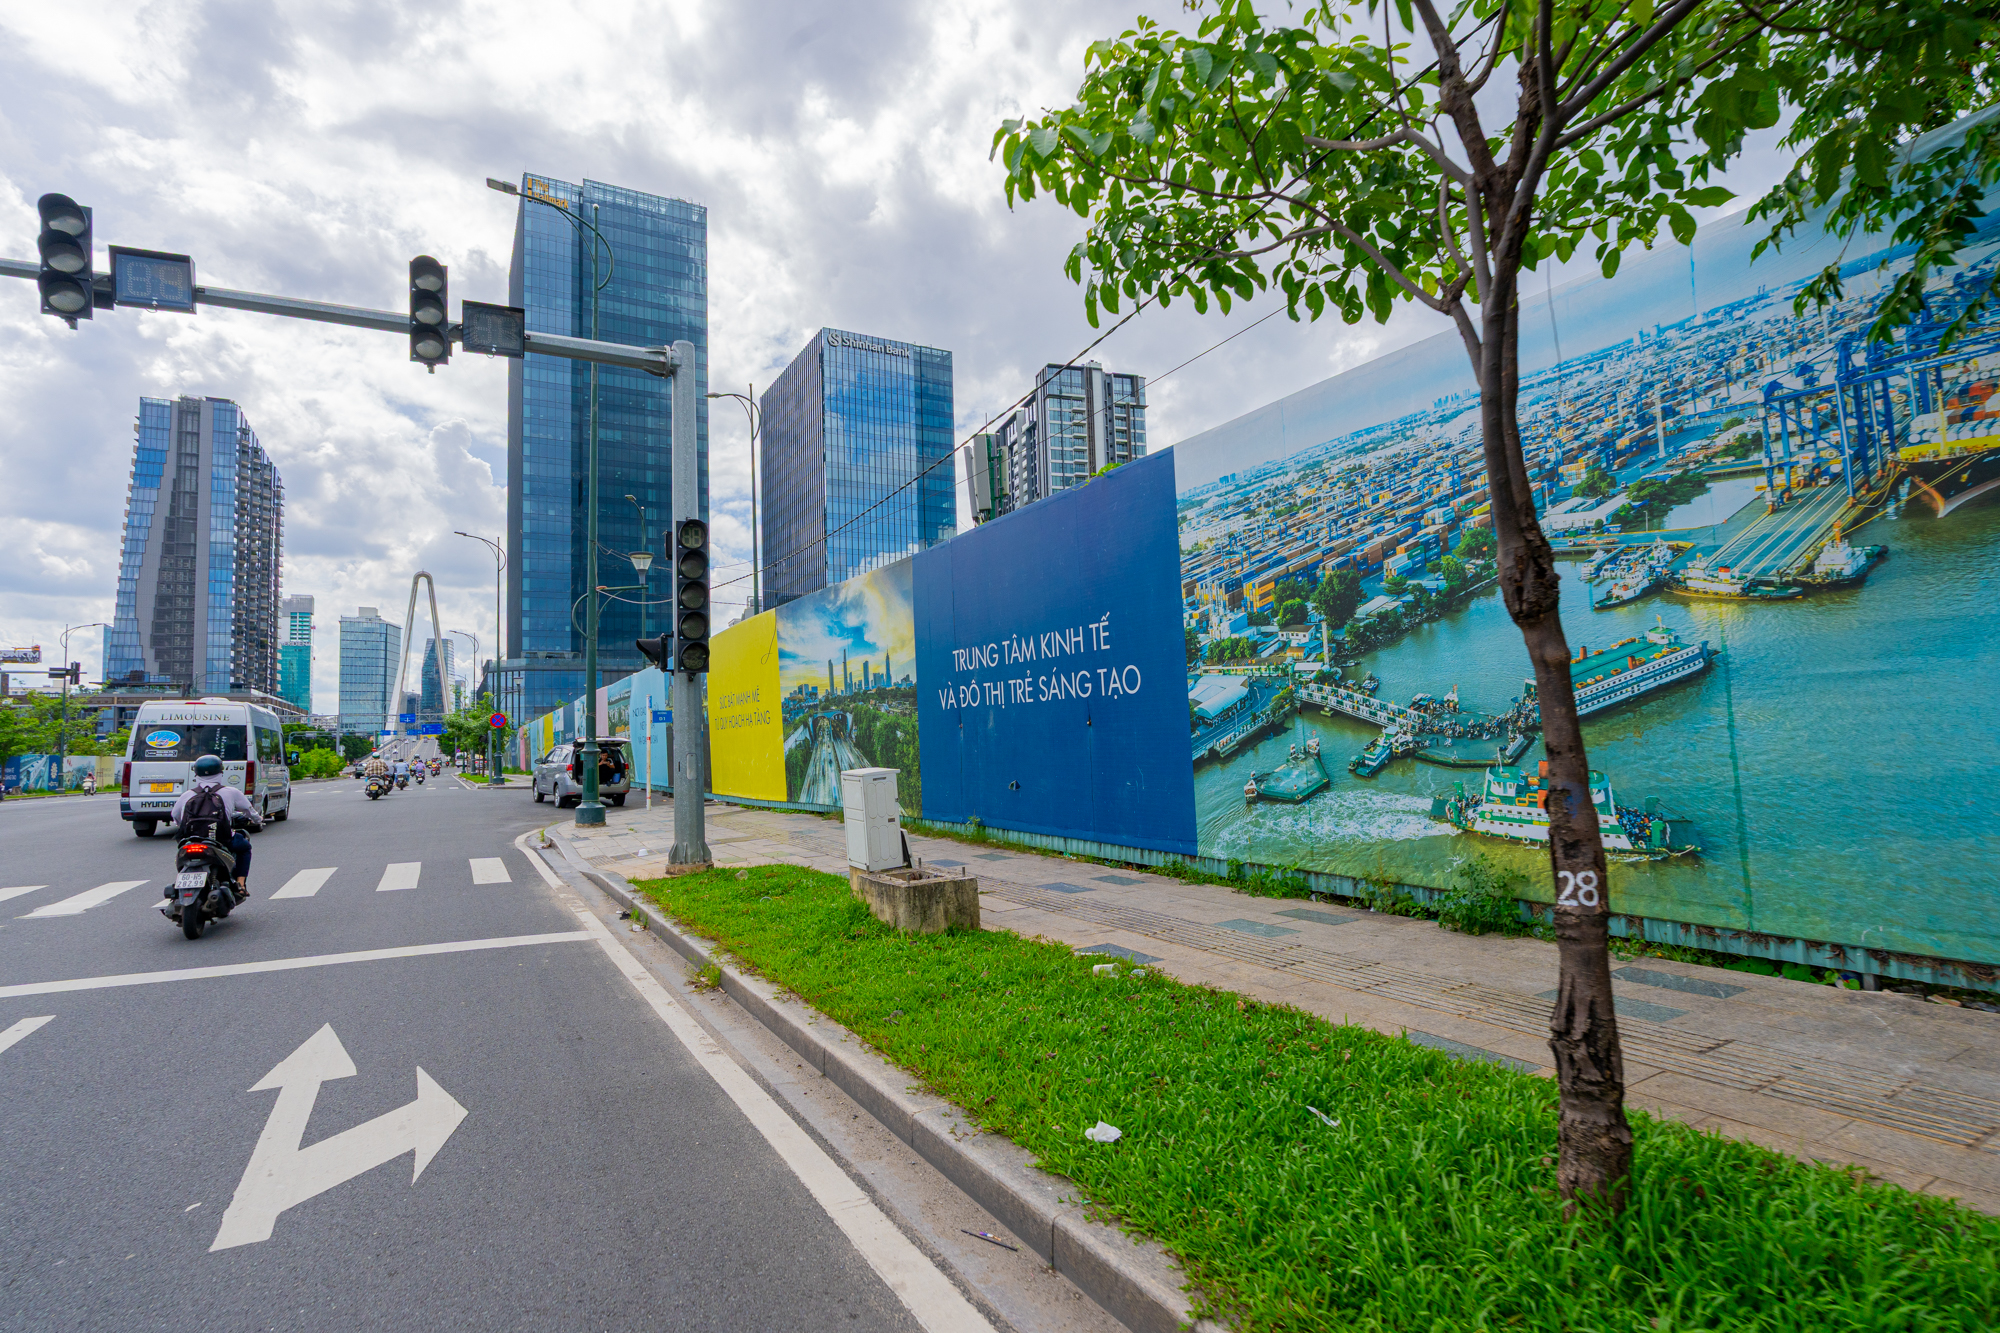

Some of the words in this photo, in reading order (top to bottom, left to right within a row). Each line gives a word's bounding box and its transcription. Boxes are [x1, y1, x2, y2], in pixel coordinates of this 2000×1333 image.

[534, 178, 549, 192] The
[534, 191, 569, 209] Hallmark
[842, 336, 885, 353] Shinhan
[886, 344, 911, 358] Bank
[952, 643, 999, 672] TRUNG
[1002, 633, 1036, 664] TÂM
[1040, 625, 1084, 659] KINH
[1088, 611, 1111, 651] TẾ
[939, 681, 957, 710] VÀ
[959, 679, 980, 708] ĐÔ
[983, 681, 1005, 709] THỊ
[1008, 670, 1034, 704] TRẺ
[1039, 667, 1093, 702] SÁNG
[1096, 664, 1142, 700] TẠO
[161, 713, 231, 721] LIMOUSINE
[1557, 870, 1600, 907] 28
